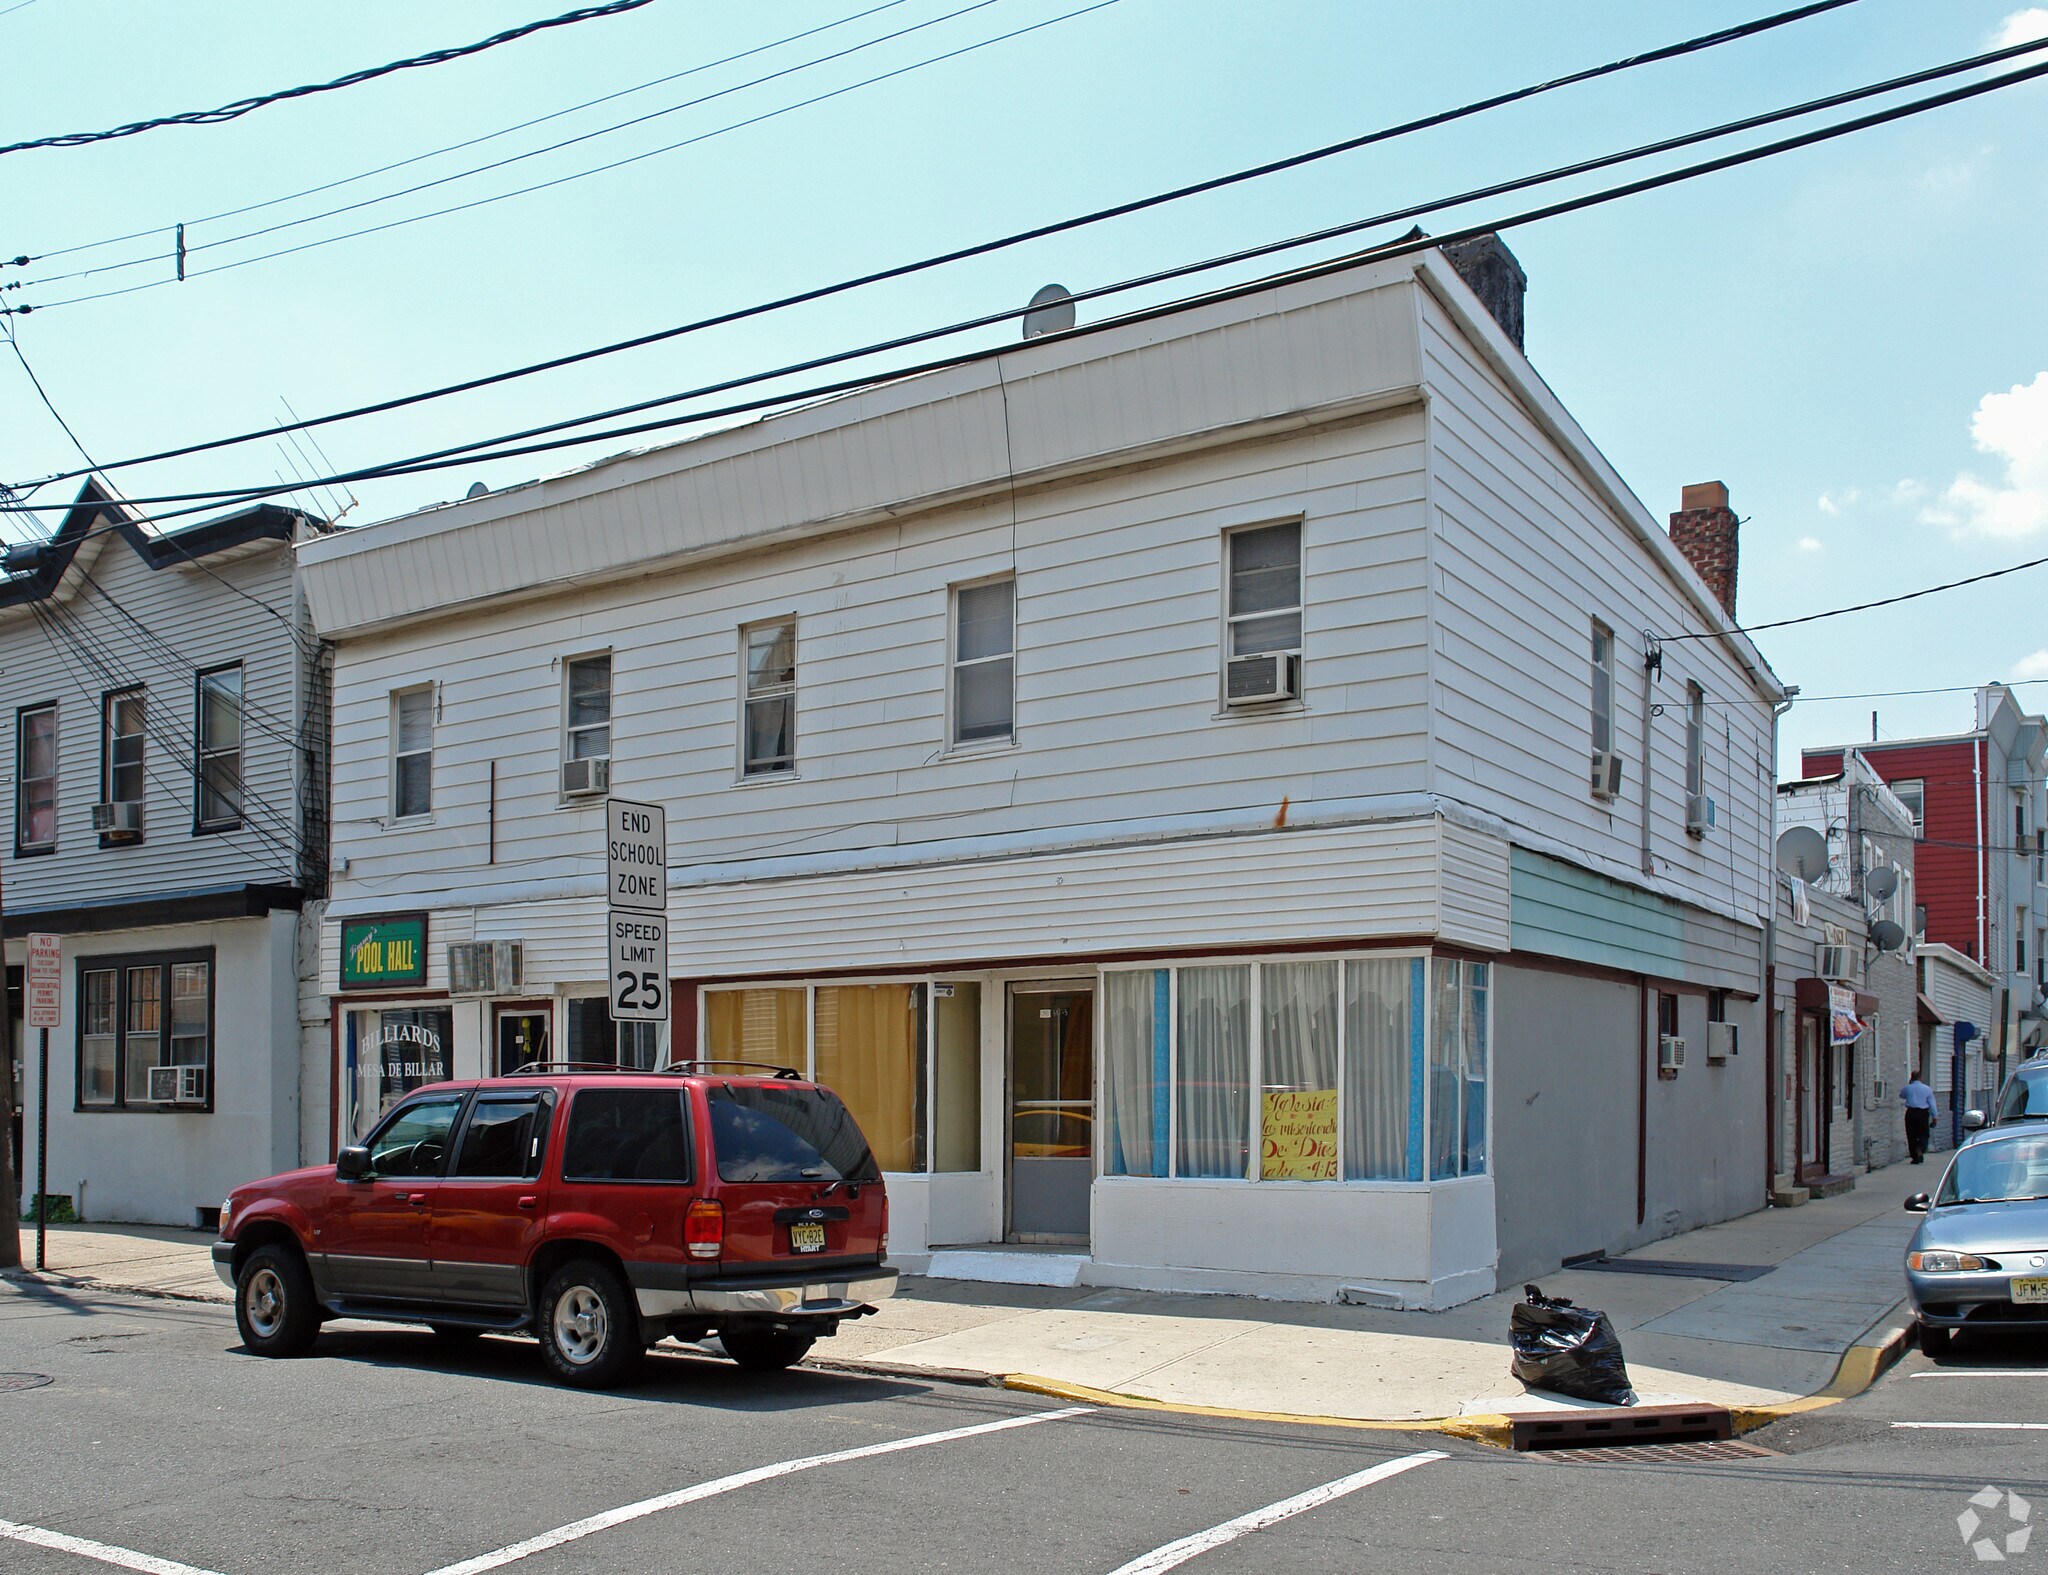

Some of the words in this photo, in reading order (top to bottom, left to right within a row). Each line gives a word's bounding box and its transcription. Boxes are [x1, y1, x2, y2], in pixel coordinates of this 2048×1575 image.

[622, 811, 651, 833] END
[611, 841, 663, 866] SCHOOL
[618, 873, 657, 896] ZONE
[615, 922, 661, 941] SPEED
[40, 937, 52, 947] NO
[31, 948, 61, 958] PARKING
[356, 941, 383, 973] POOL
[387, 940, 414, 971] HALL
[621, 945, 656, 963] LIMIT
[617, 970, 662, 1010] 25
[36, 997, 55, 1005] PARKING
[361, 1024, 441, 1055] BILLIARDS
[357, 1063, 386, 1078] MESA
[388, 1062, 402, 1077] DE
[404, 1061, 444, 1077] BILLAR
